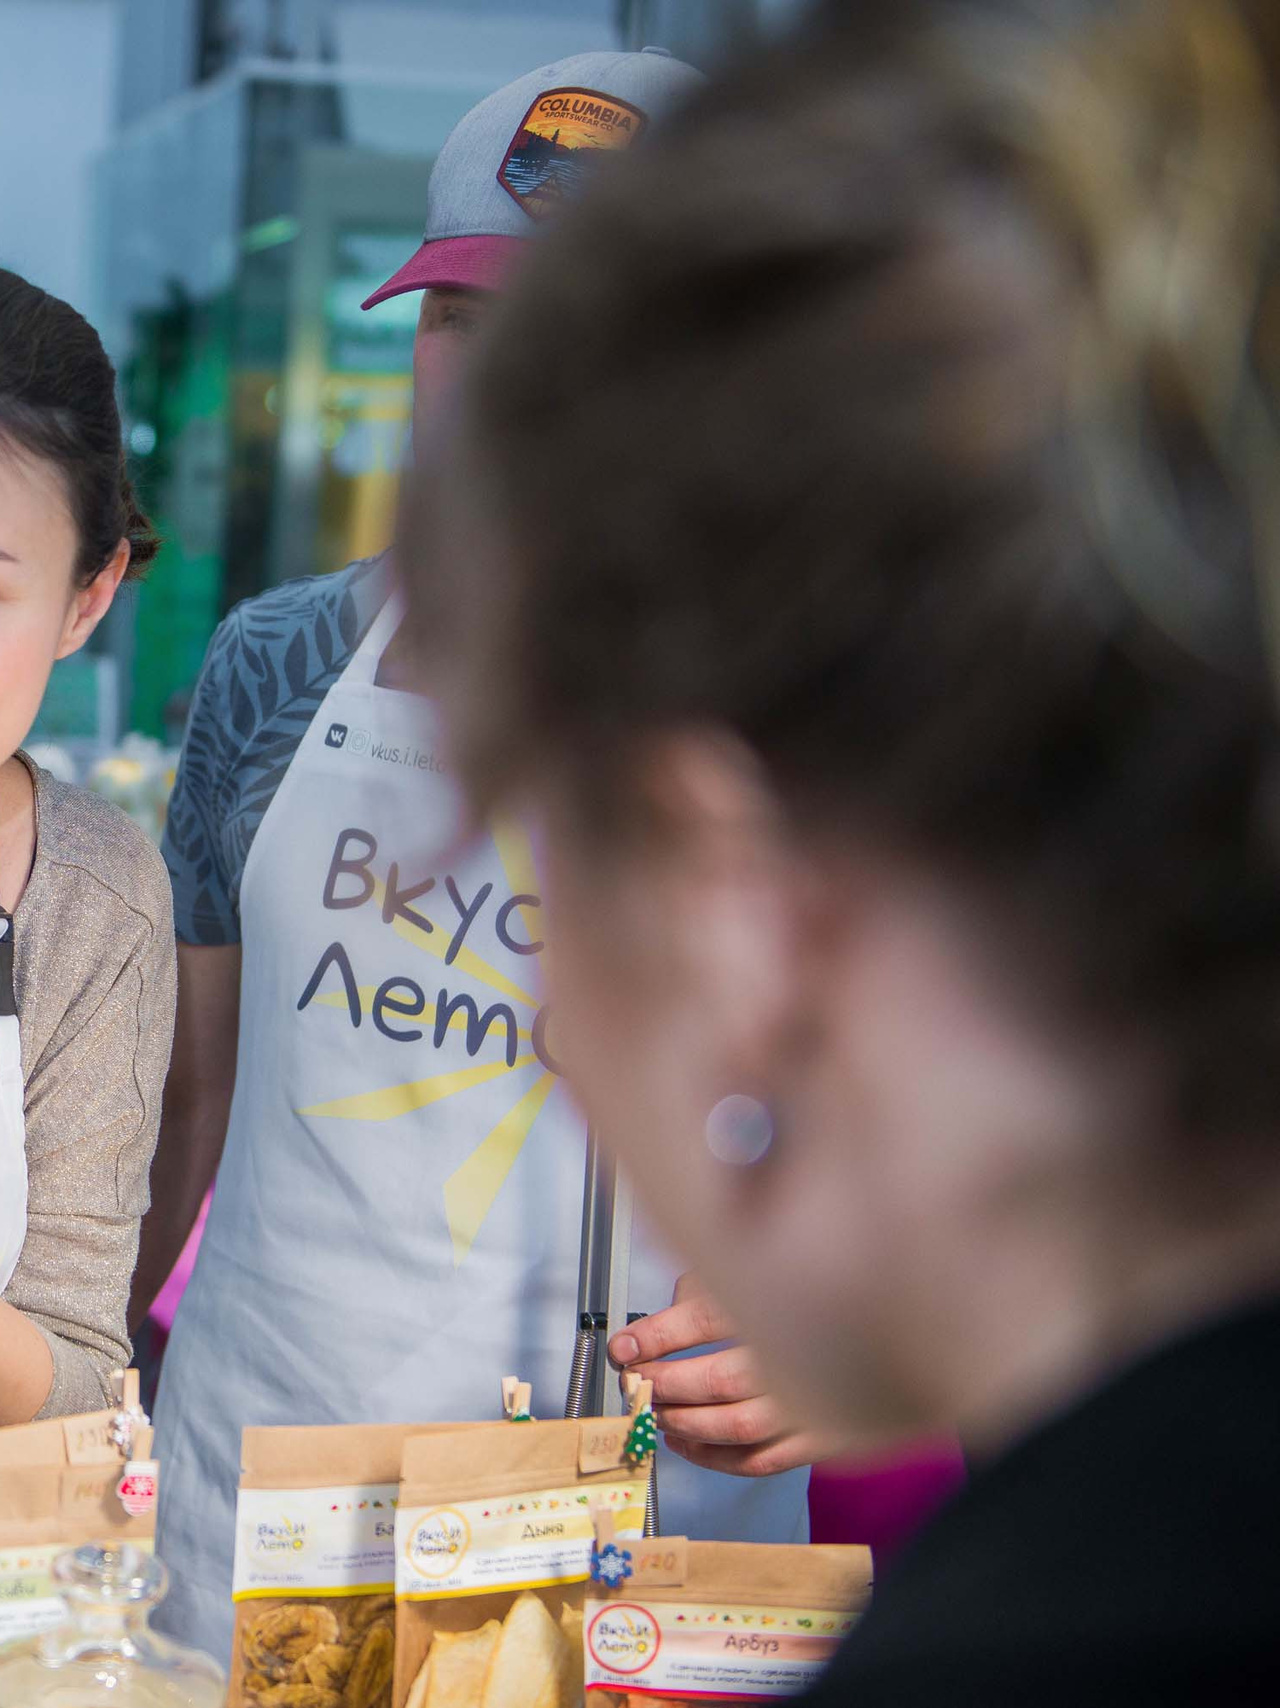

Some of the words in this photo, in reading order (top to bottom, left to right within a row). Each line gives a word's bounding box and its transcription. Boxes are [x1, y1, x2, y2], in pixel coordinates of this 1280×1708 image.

[539, 98, 632, 132] COLUMBIA
[544, 111, 600, 127] SPORTSWEAR
[323, 828, 545, 966] Вкус
[521, 1522, 564, 1539] Дыня
[724, 1633, 780, 1655] Арбуз
